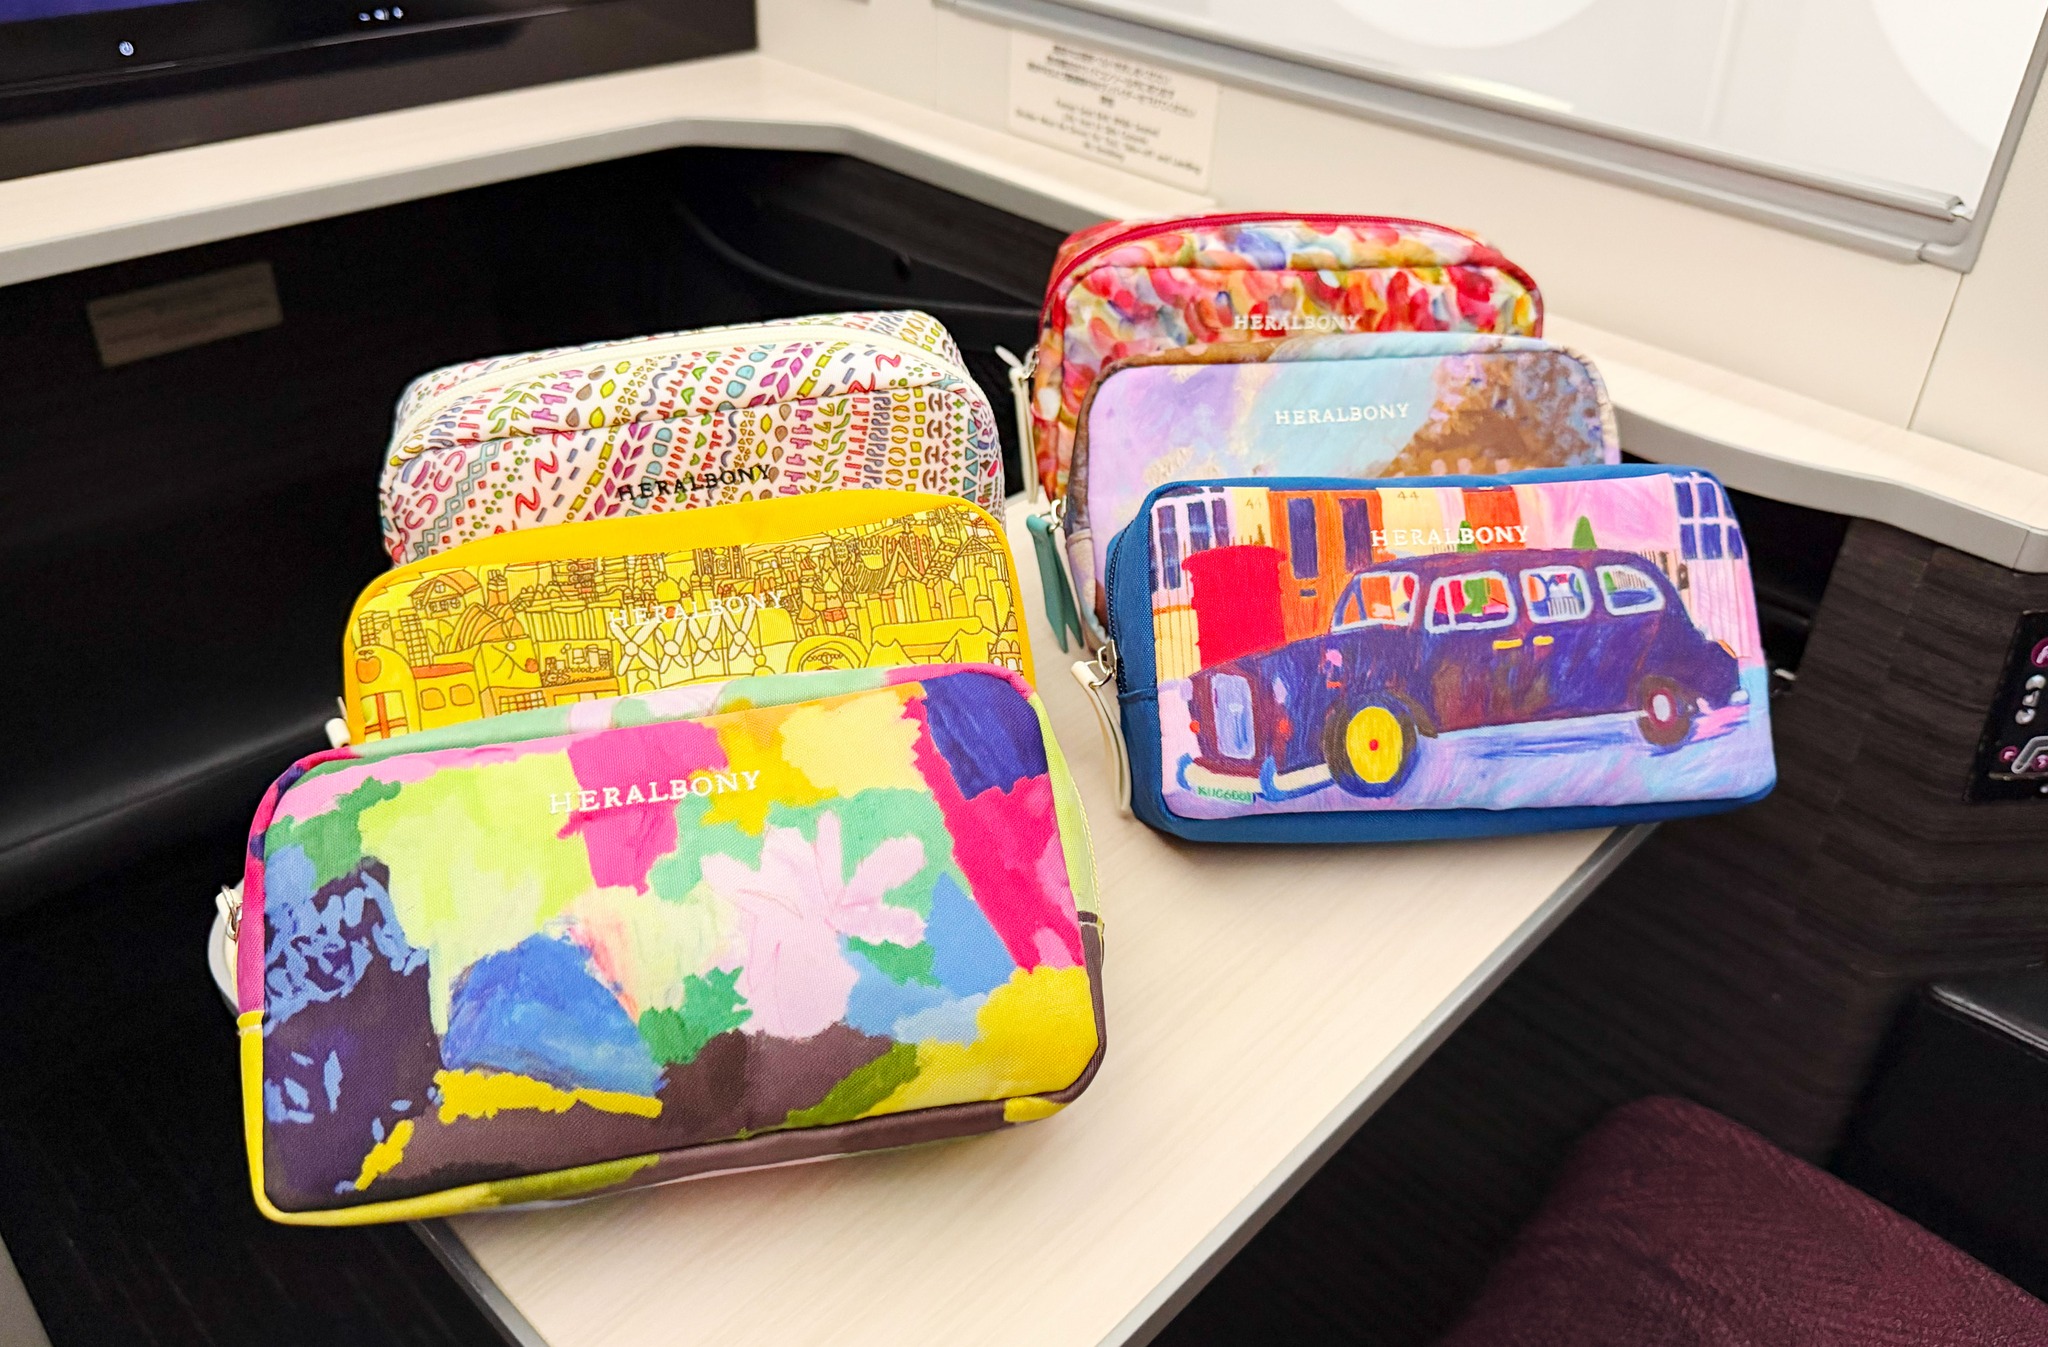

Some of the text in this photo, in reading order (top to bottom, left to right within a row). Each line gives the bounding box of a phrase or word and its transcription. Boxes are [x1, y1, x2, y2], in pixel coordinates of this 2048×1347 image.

[1234, 314, 1360, 331] HERALBONY
[1274, 402, 1409, 425] HERALBONY
[617, 463, 770, 501] HERALBONY
[1371, 525, 1529, 546] HERALBONY
[609, 589, 787, 628] HERALBONY
[550, 770, 761, 814] HERALBONY
